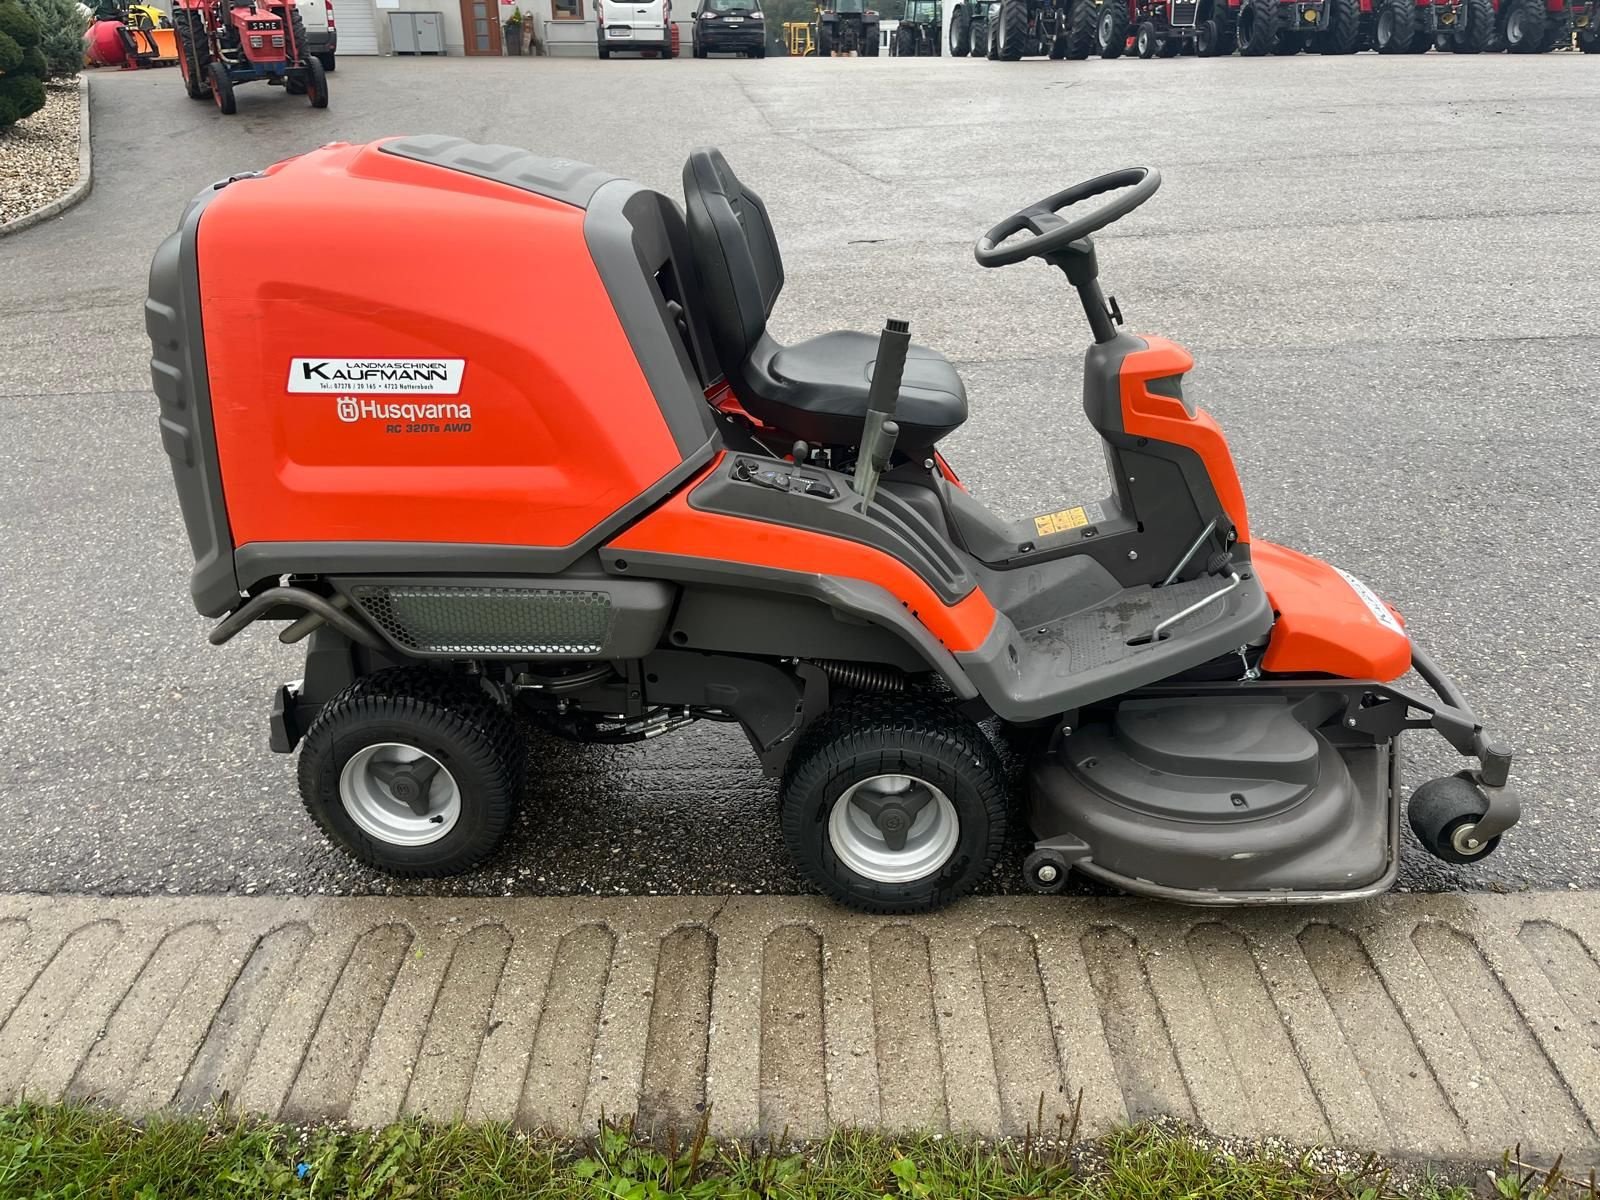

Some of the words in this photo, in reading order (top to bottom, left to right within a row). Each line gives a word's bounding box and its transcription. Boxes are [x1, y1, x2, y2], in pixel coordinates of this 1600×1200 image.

[252, 22, 277, 30] SAME
[302, 362, 448, 381] KAUFMANN
[360, 400, 472, 421] Husqvarna
[386, 424, 402, 433] RC
[443, 423, 472, 433] AWD
